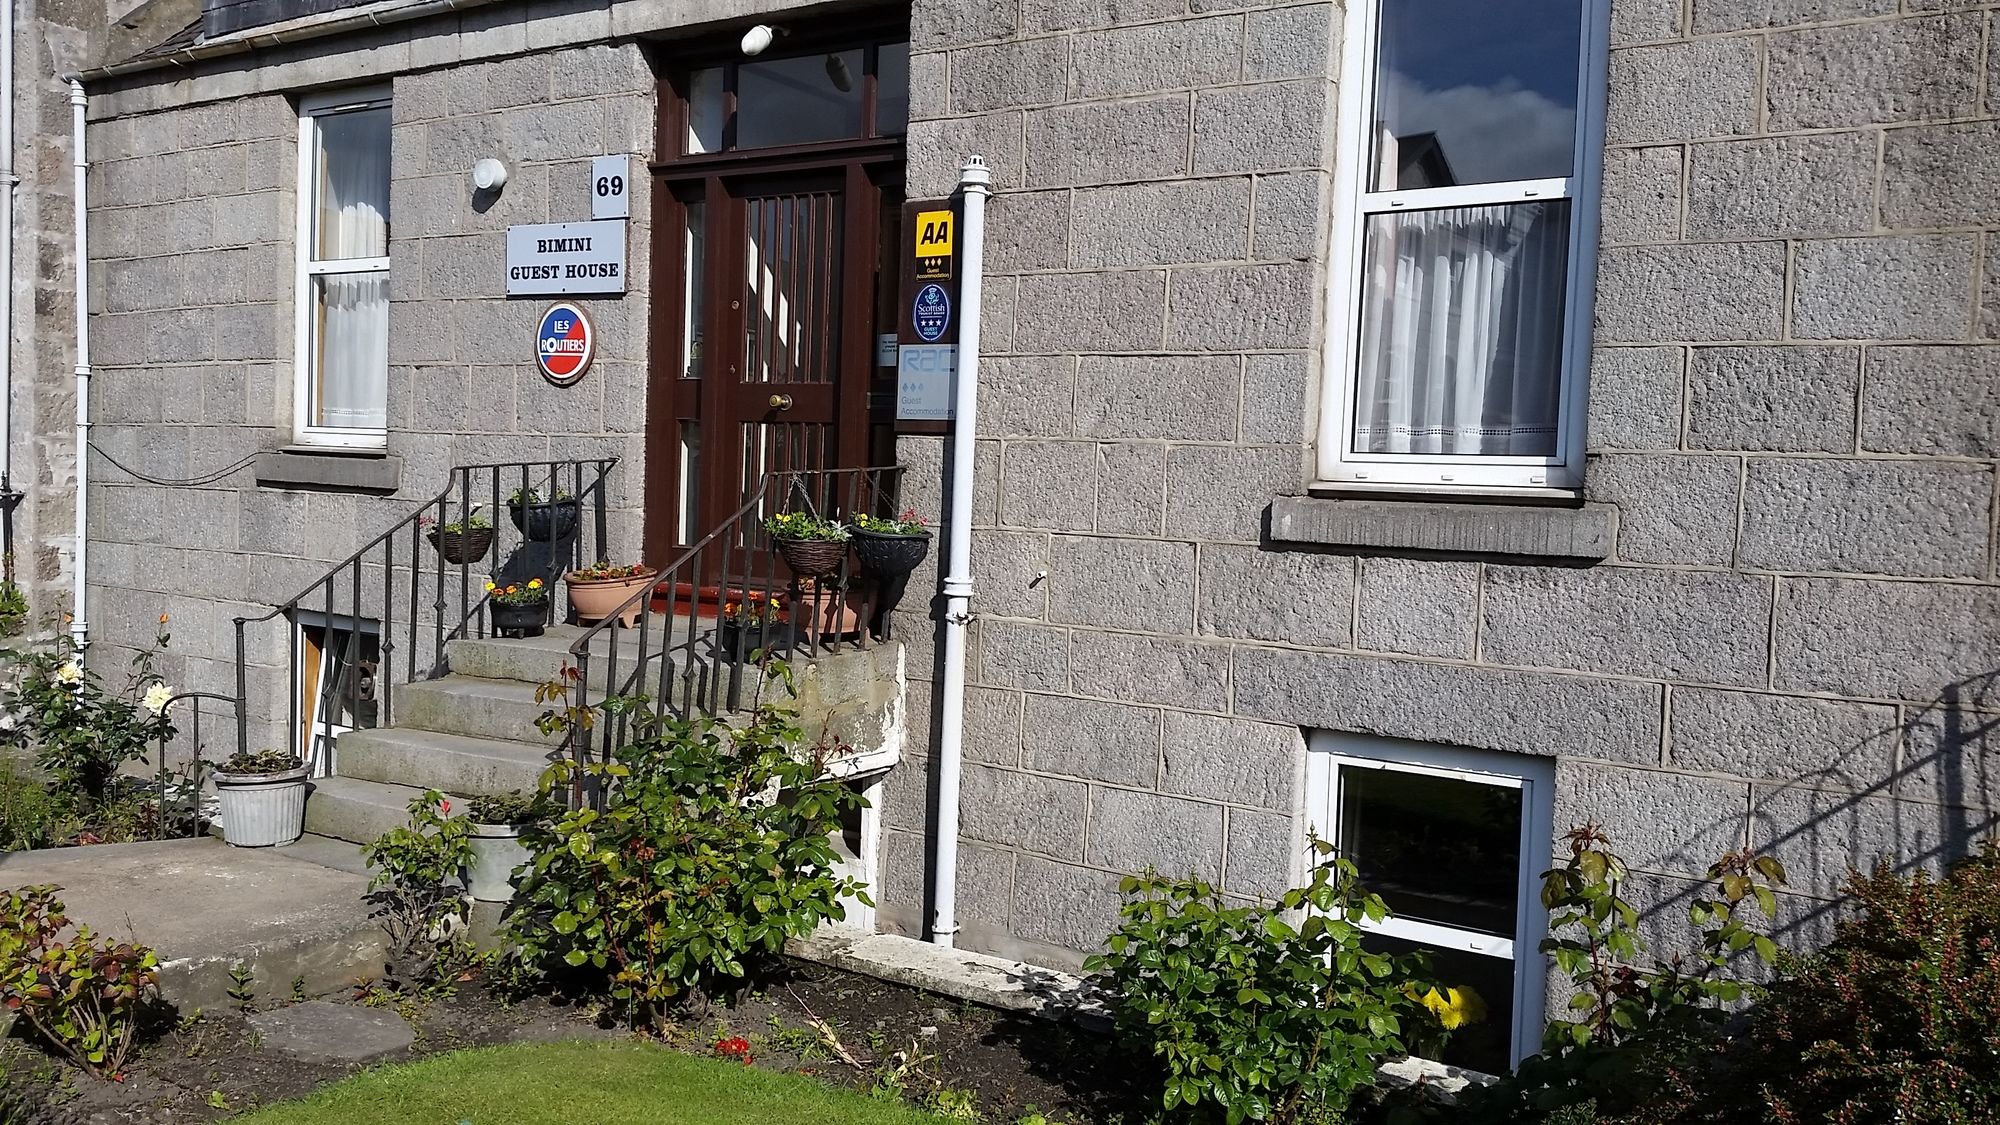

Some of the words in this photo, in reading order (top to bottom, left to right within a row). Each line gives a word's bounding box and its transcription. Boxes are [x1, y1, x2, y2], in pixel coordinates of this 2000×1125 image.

[596, 175, 624, 197] 69
[920, 221, 948, 245] AA
[537, 237, 592, 253] BIMINI
[510, 265, 560, 280] GUEST
[565, 263, 619, 278] HOUSE
[918, 303, 945, 313] Scottish
[554, 320, 570, 333] LES
[541, 337, 585, 353] ROUTIERS
[901, 396, 922, 405] Guest
[901, 407, 954, 416] Accommodation
